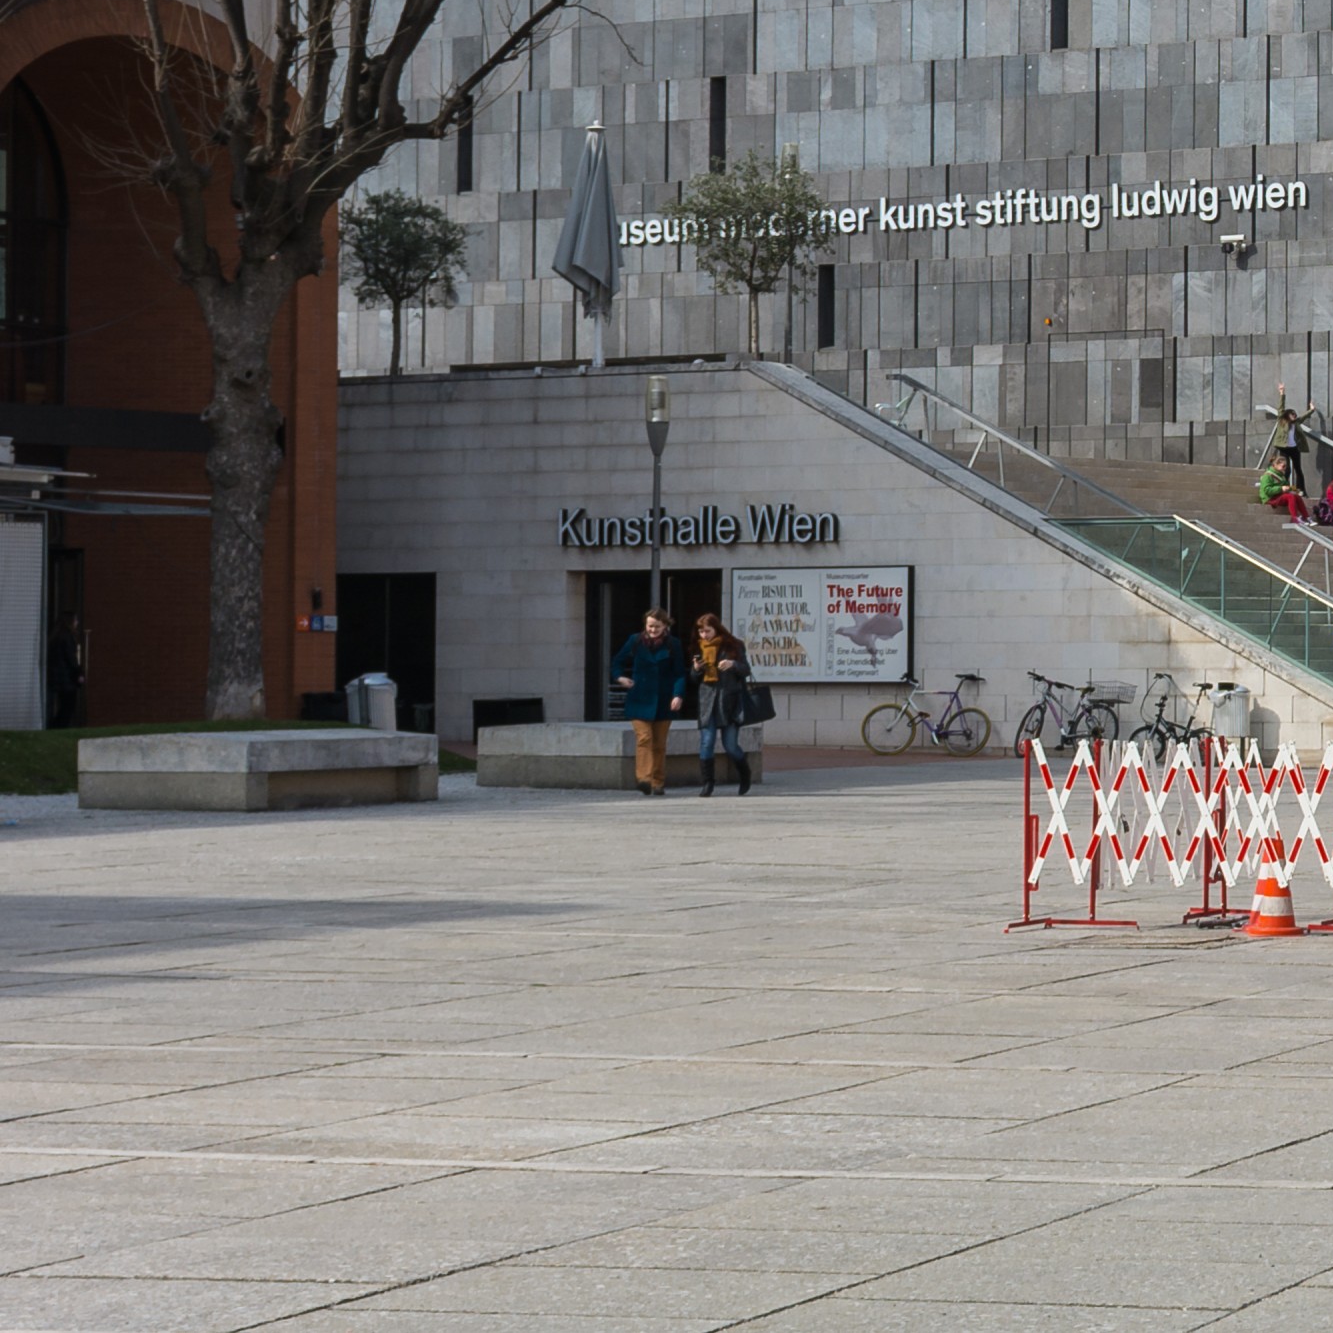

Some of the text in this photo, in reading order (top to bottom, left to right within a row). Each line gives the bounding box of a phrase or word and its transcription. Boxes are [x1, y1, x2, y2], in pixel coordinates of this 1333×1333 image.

[879, 193, 967, 231] kunst
[975, 186, 1101, 229] stiftung
[1111, 178, 1219, 222] ludwig
[1228, 173, 1307, 212] wien
[559, 503, 837, 547] Kunsthalle Wien
[762, 584, 803, 599] BISMUTH
[827, 584, 903, 598] The Future
[827, 599, 902, 617] of Memory
